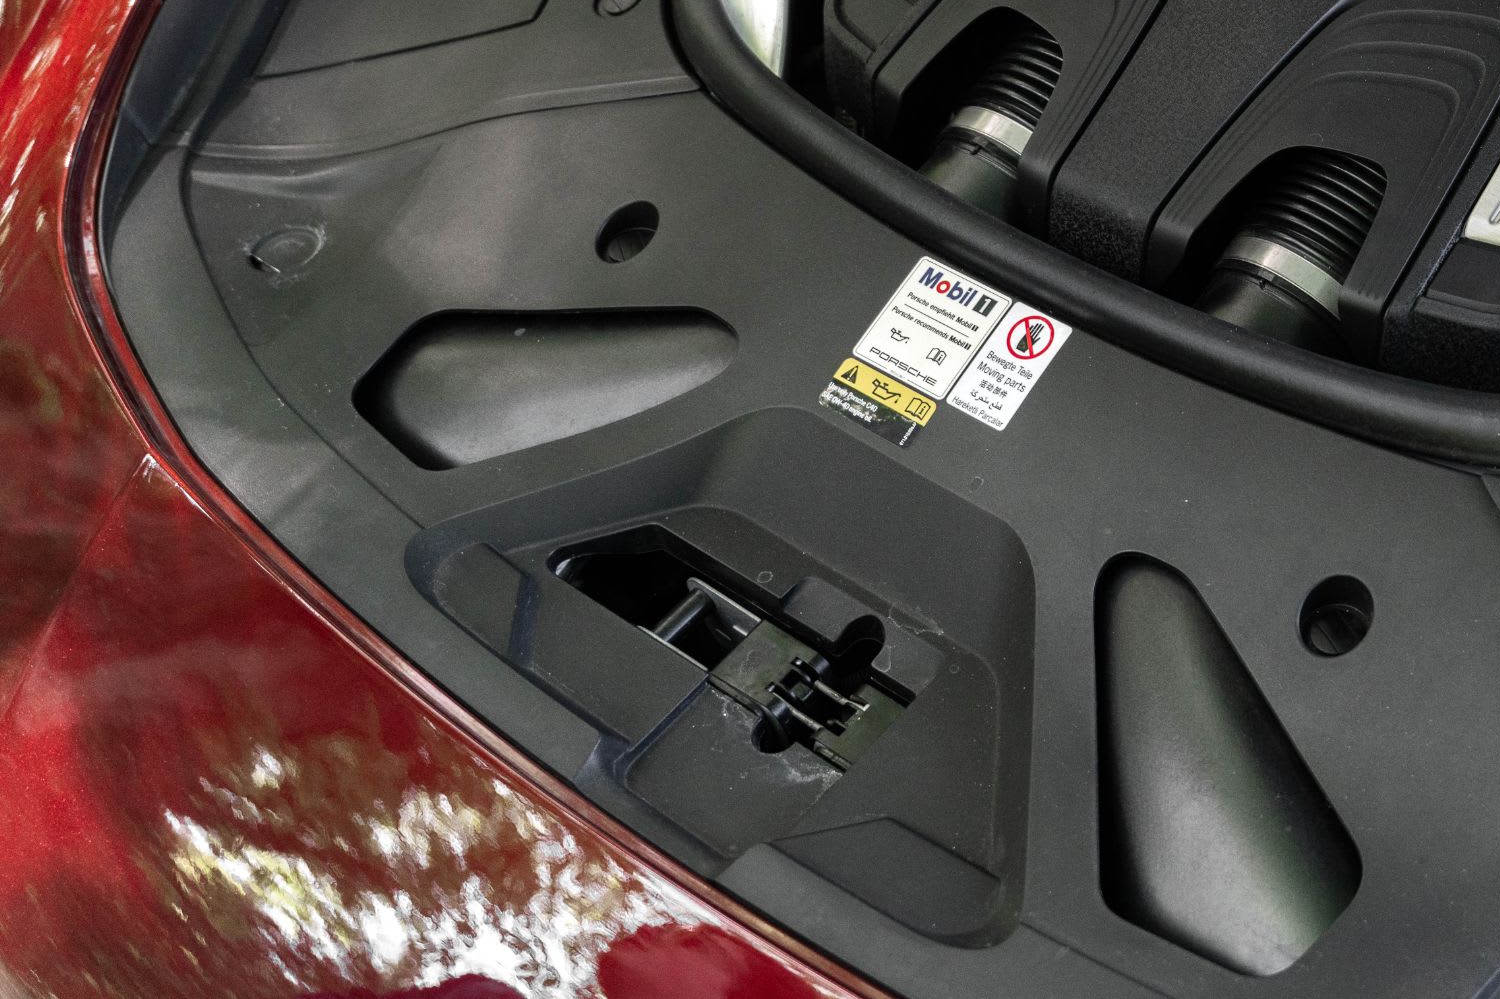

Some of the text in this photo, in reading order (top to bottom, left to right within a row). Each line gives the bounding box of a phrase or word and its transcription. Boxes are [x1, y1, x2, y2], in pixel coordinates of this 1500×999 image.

[918, 266, 978, 307] Mobil
[907, 292, 930, 307] Porsche
[929, 303, 956, 321] empfiehlt
[892, 306, 914, 320] Porsche
[913, 318, 949, 339] recommends
[869, 346, 938, 387] PORSCHE
[977, 361, 1027, 393] Moving parts
[986, 350, 1033, 380] Bewegte Teile
[848, 391, 867, 407] Porsche
[865, 402, 879, 413] C40
[979, 379, 1008, 398] 活动部件
[848, 406, 866, 418] engine
[951, 396, 1004, 427] Hareketli Parçalar
